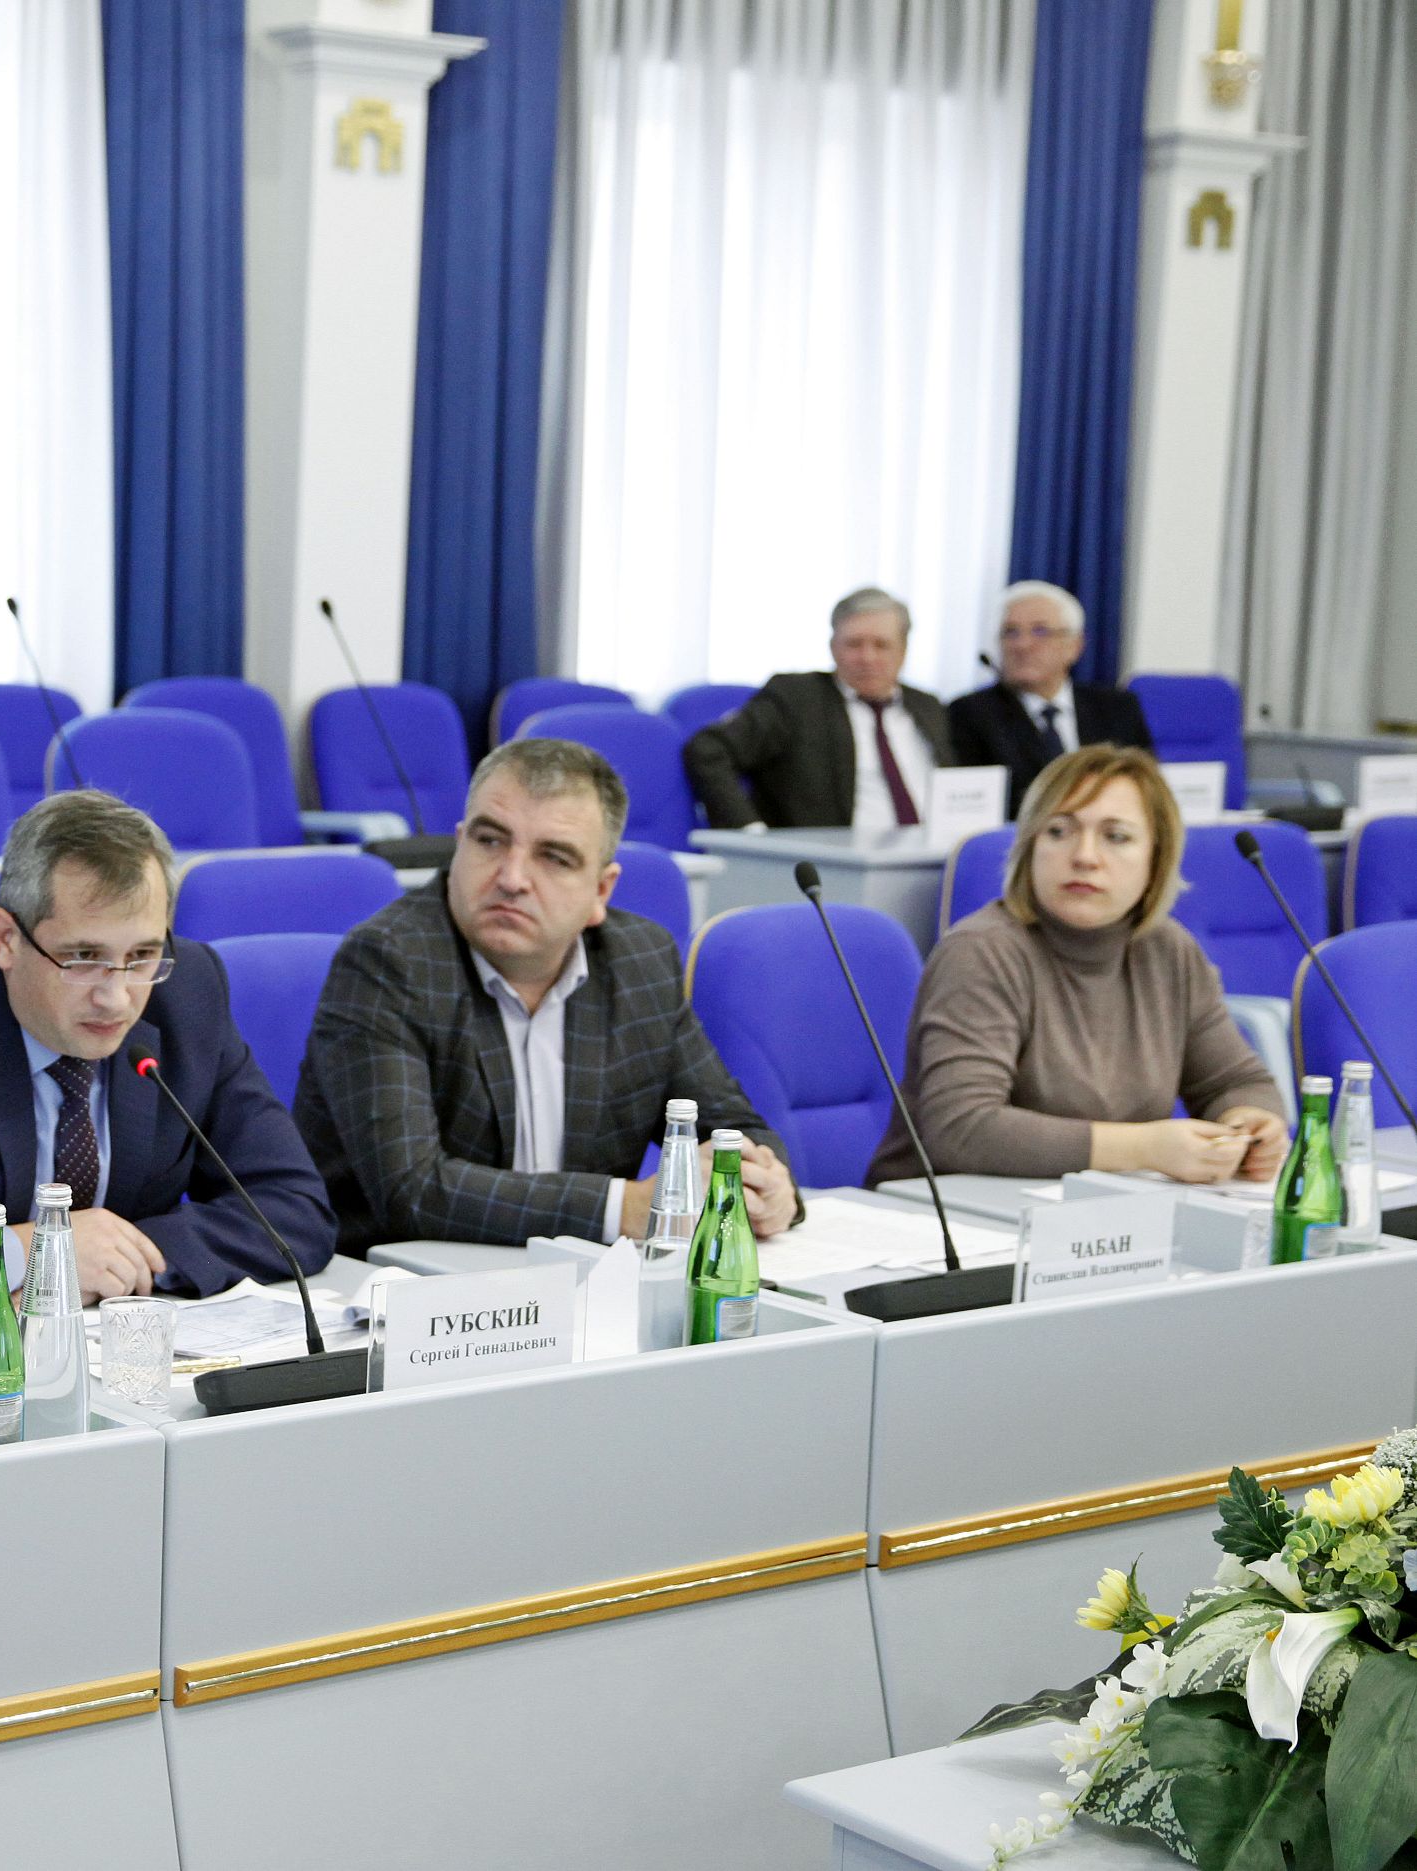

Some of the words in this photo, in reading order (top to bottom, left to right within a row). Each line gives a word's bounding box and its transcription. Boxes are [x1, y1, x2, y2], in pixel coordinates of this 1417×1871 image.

[1071, 1235, 1132, 1259] ЧАБАН
[430, 1300, 542, 1337] ГУБСКИЙ
[409, 1344, 460, 1366] Сергей
[465, 1336, 557, 1358] Геннадьевич
